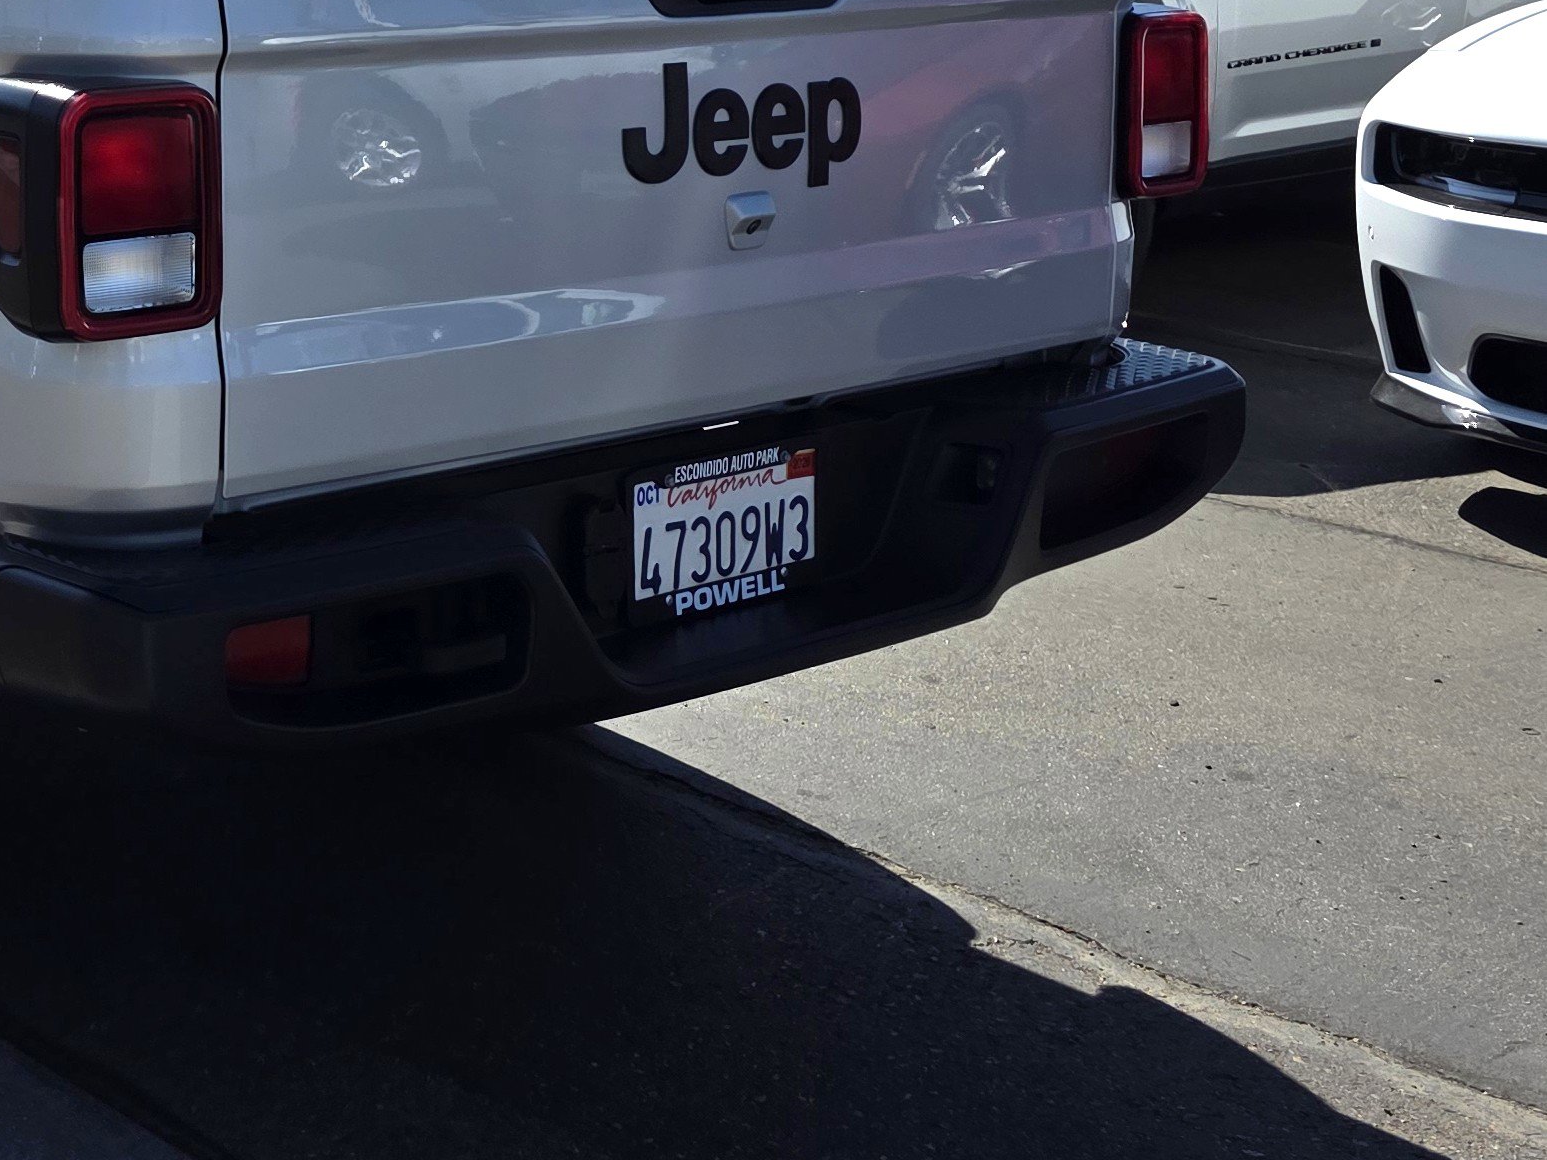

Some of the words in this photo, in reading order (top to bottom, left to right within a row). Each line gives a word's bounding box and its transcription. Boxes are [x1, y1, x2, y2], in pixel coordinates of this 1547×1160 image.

[1227, 54, 1282, 69] GRAND
[1284, 40, 1367, 59] CHEROKEE
[622, 62, 862, 188] Jeep
[675, 456, 729, 483] ESCONDIDO
[731, 451, 755, 475] AUTO
[756, 446, 780, 467] PARK
[637, 485, 660, 507] OCT
[667, 468, 787, 510] California
[640, 495, 810, 595] 47309W3
[675, 571, 785, 616] POWELL
